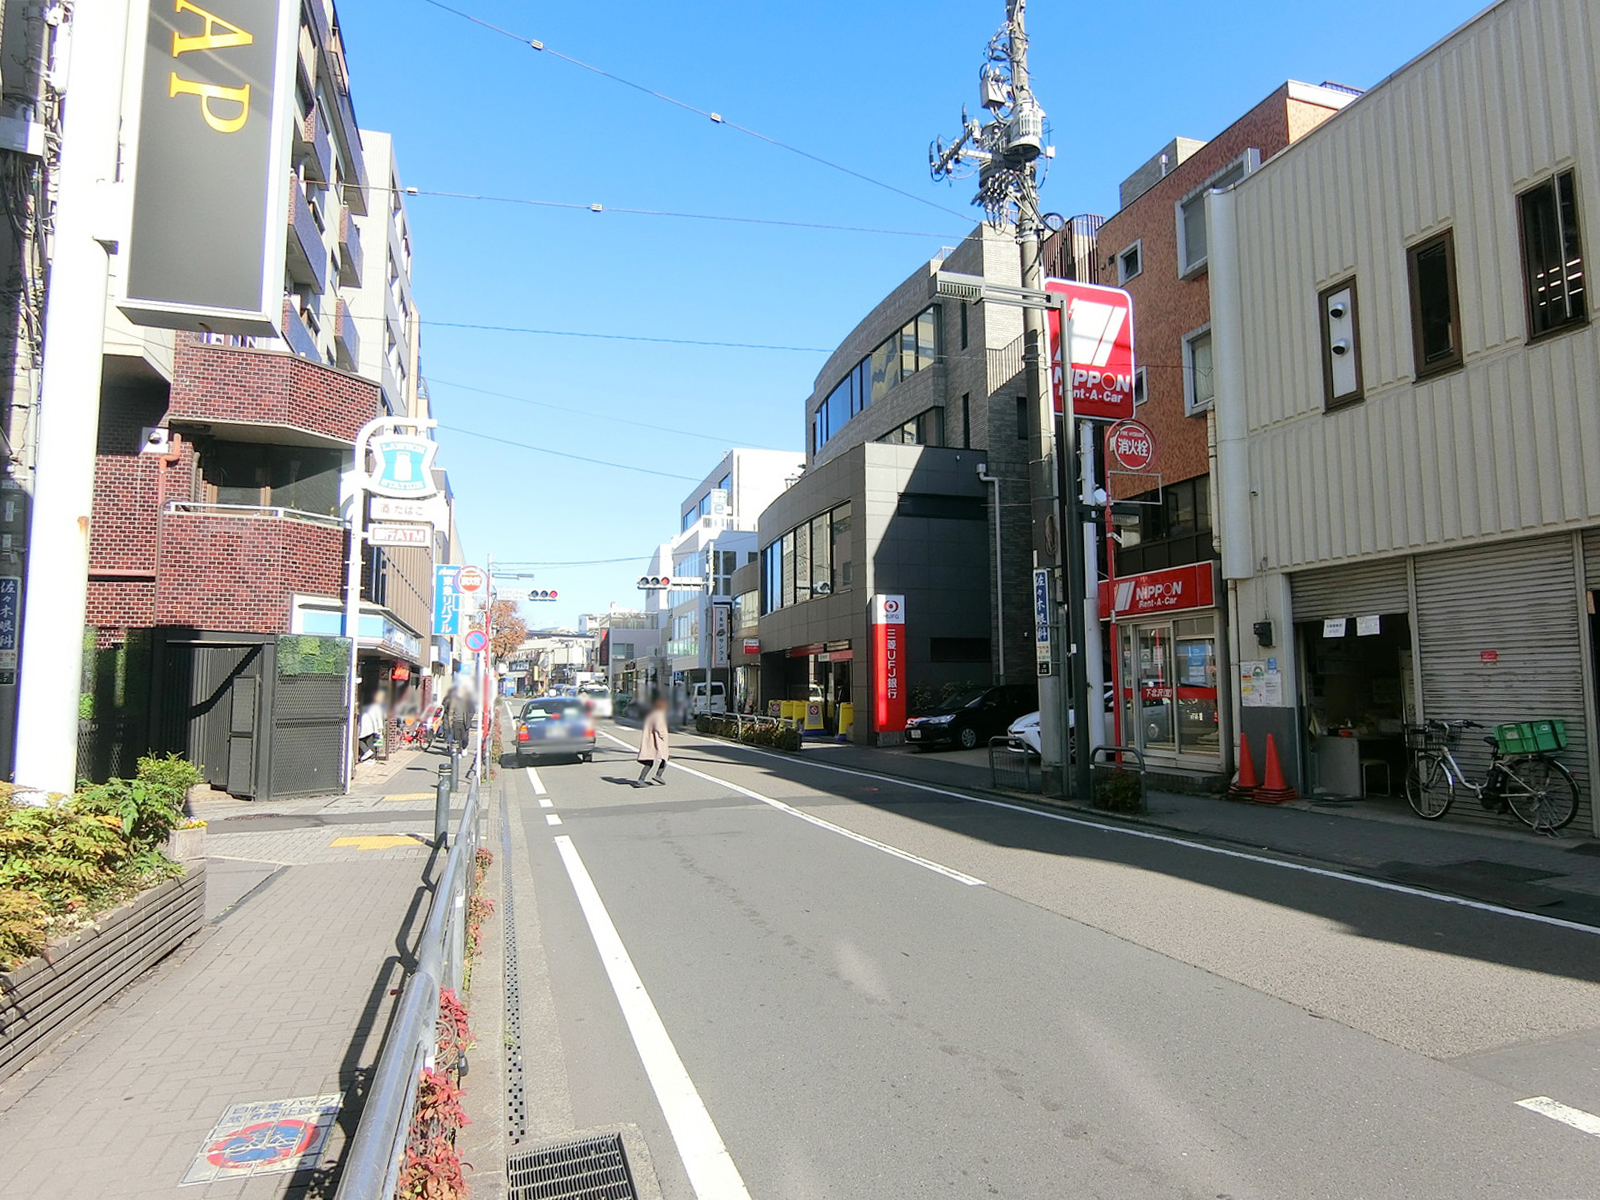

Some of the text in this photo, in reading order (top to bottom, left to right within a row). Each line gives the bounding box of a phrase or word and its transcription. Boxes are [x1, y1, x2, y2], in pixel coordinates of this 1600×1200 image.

[1117, 438, 1149, 457] 消火栓
[441, 576, 454, 634] 東急リバブル
[1136, 581, 1182, 601] NIPPON
[887, 628, 898, 699] 三菱UFJ銀行
